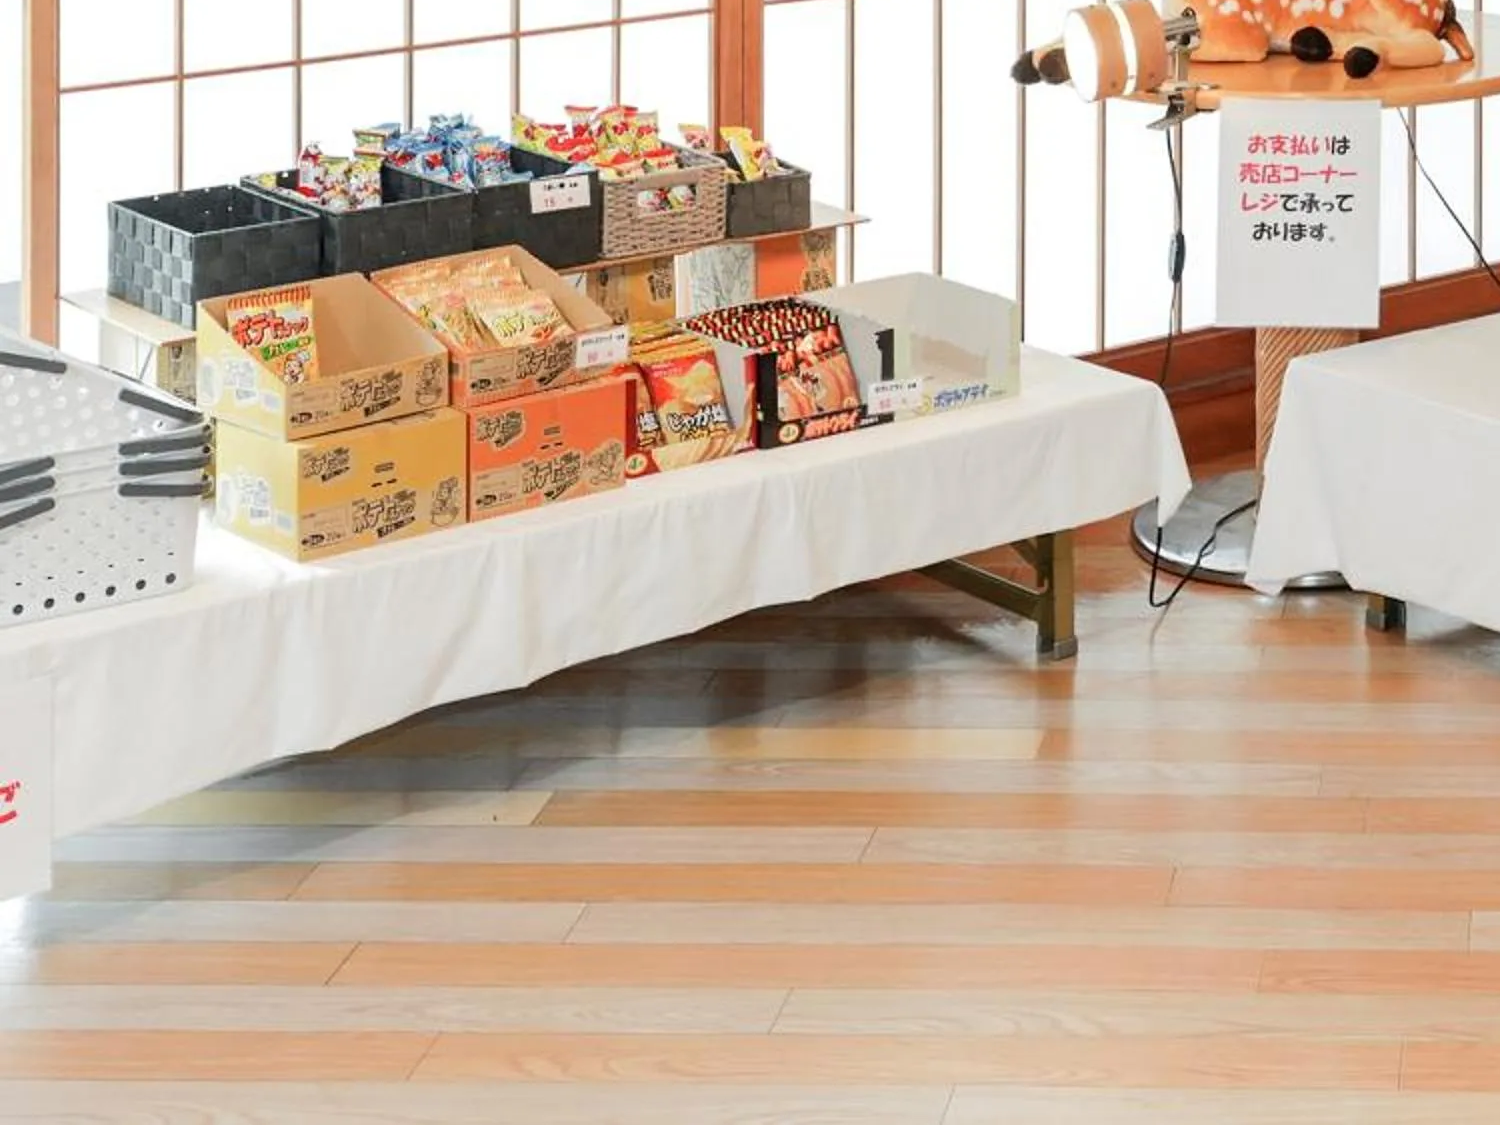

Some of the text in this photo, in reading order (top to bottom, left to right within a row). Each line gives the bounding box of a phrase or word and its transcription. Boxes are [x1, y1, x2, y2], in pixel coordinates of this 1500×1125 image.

[1248, 135, 1351, 156] お支払いは
[1240, 163, 1358, 184] 売店コーナー
[1241, 193, 1354, 212] レジで承って
[1252, 222, 1336, 242] おります。
